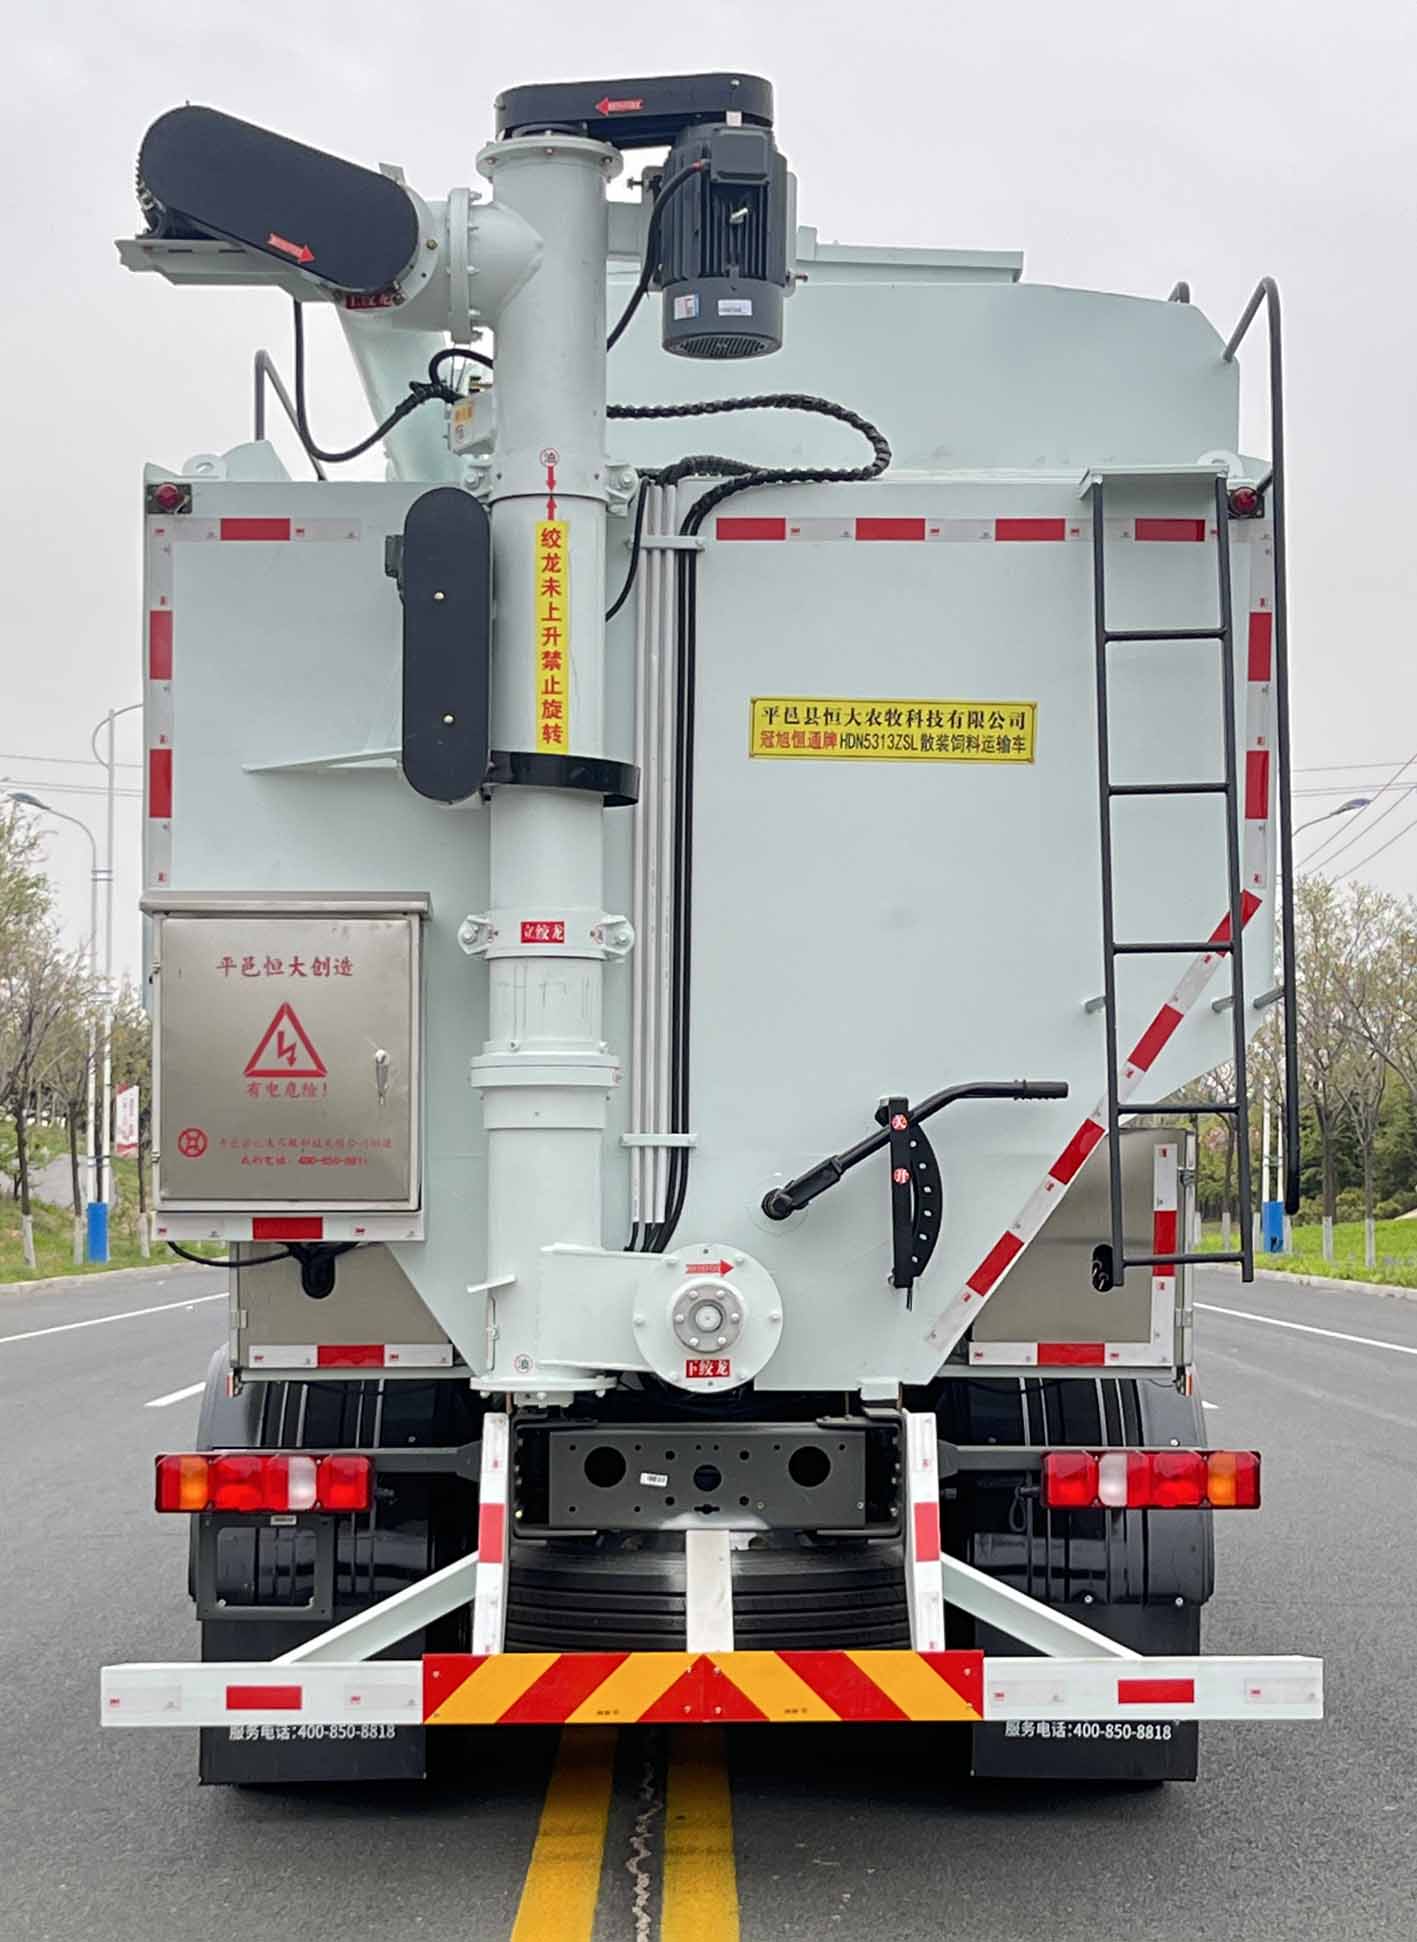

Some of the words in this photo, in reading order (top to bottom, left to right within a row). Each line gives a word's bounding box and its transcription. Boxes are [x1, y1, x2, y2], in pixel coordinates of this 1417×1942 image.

[540, 527, 563, 744] 绞龙未上升禁止旋转
[761, 705, 1027, 730] 平邑县恒大农牧科技有限公司
[215, 956, 354, 977] 平邑恒大创造
[229, 1724, 396, 1740] 服务电话:400-850-8818
[1004, 1720, 1173, 1740] 服务电话:400-850-8818
